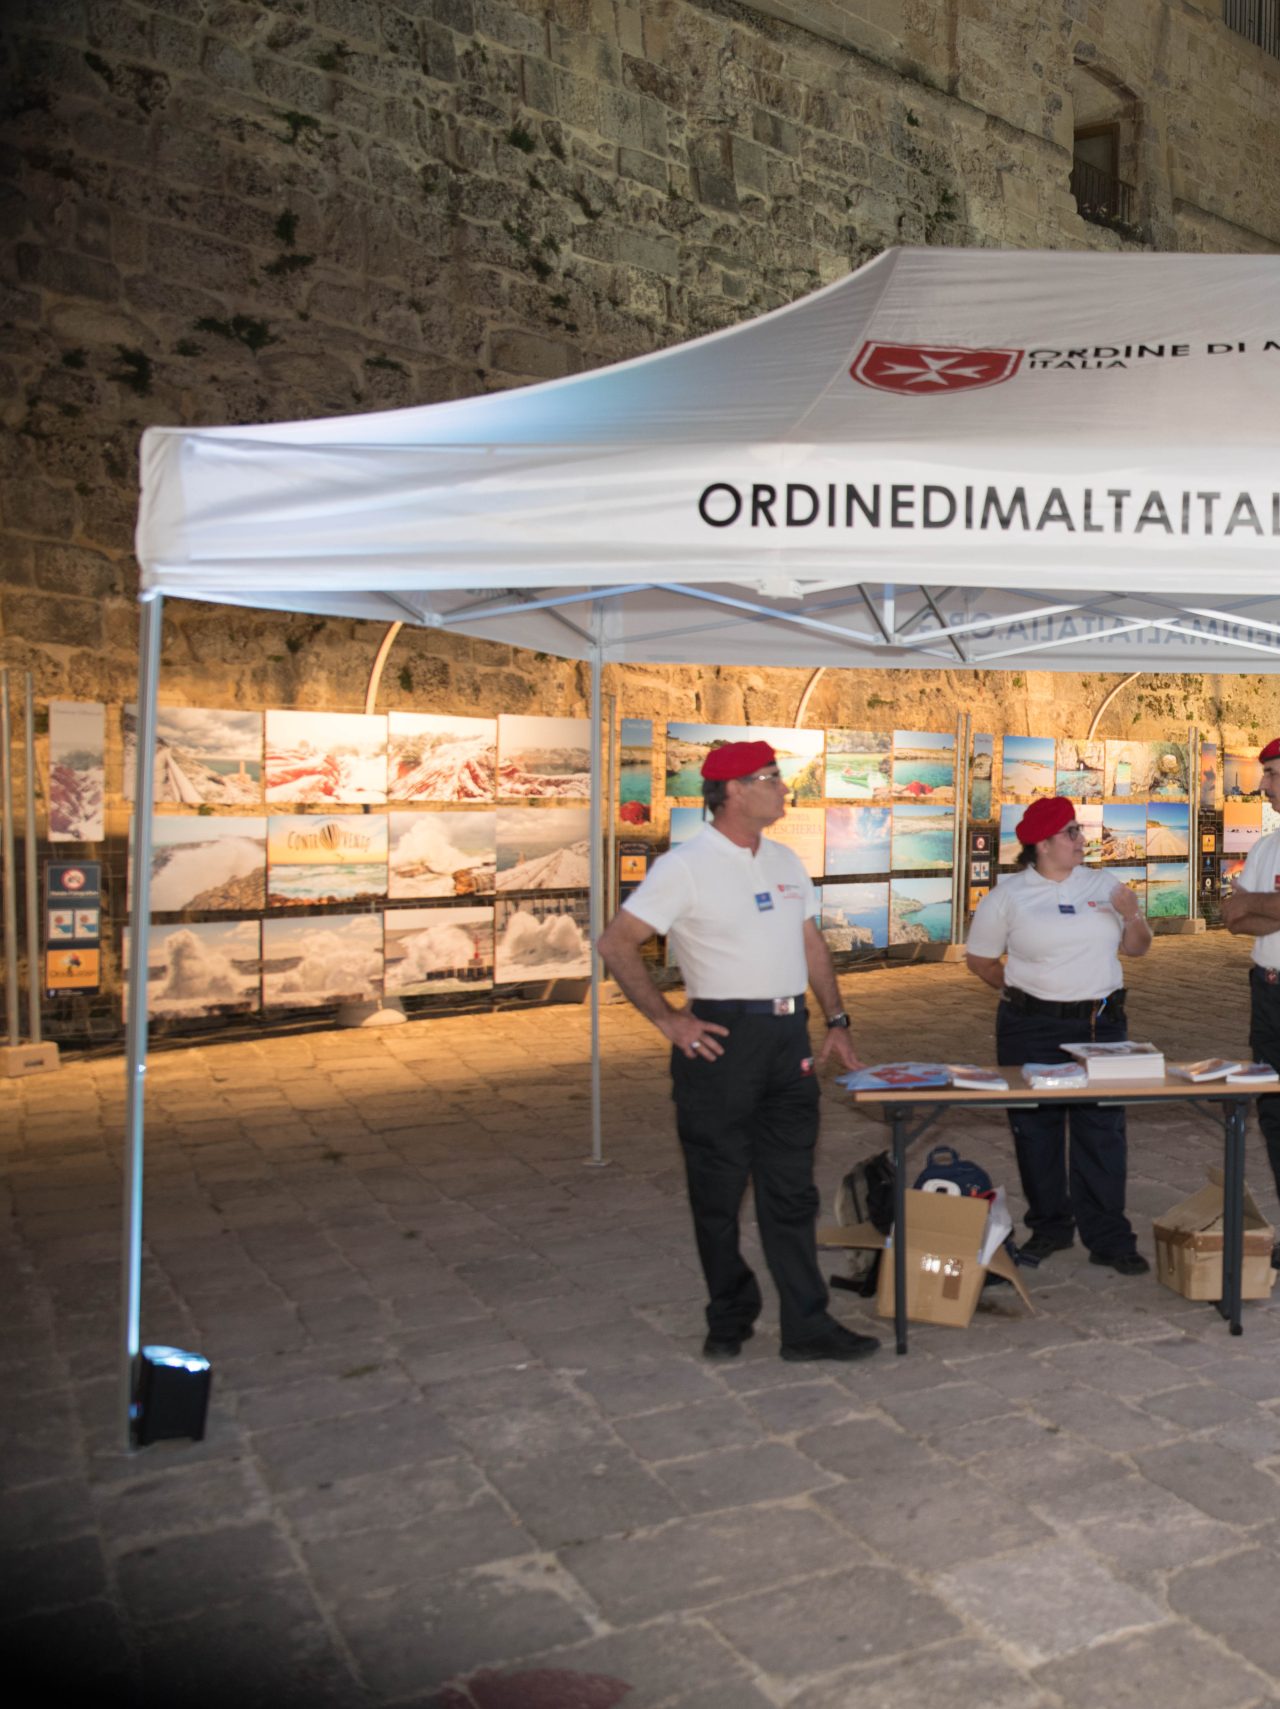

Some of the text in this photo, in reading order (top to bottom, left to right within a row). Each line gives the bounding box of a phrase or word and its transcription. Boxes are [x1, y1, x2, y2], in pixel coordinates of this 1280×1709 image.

[1028, 344, 1191, 359] ORDINE
[1207, 342, 1246, 355] DI
[1029, 360, 1128, 369] ITALIA
